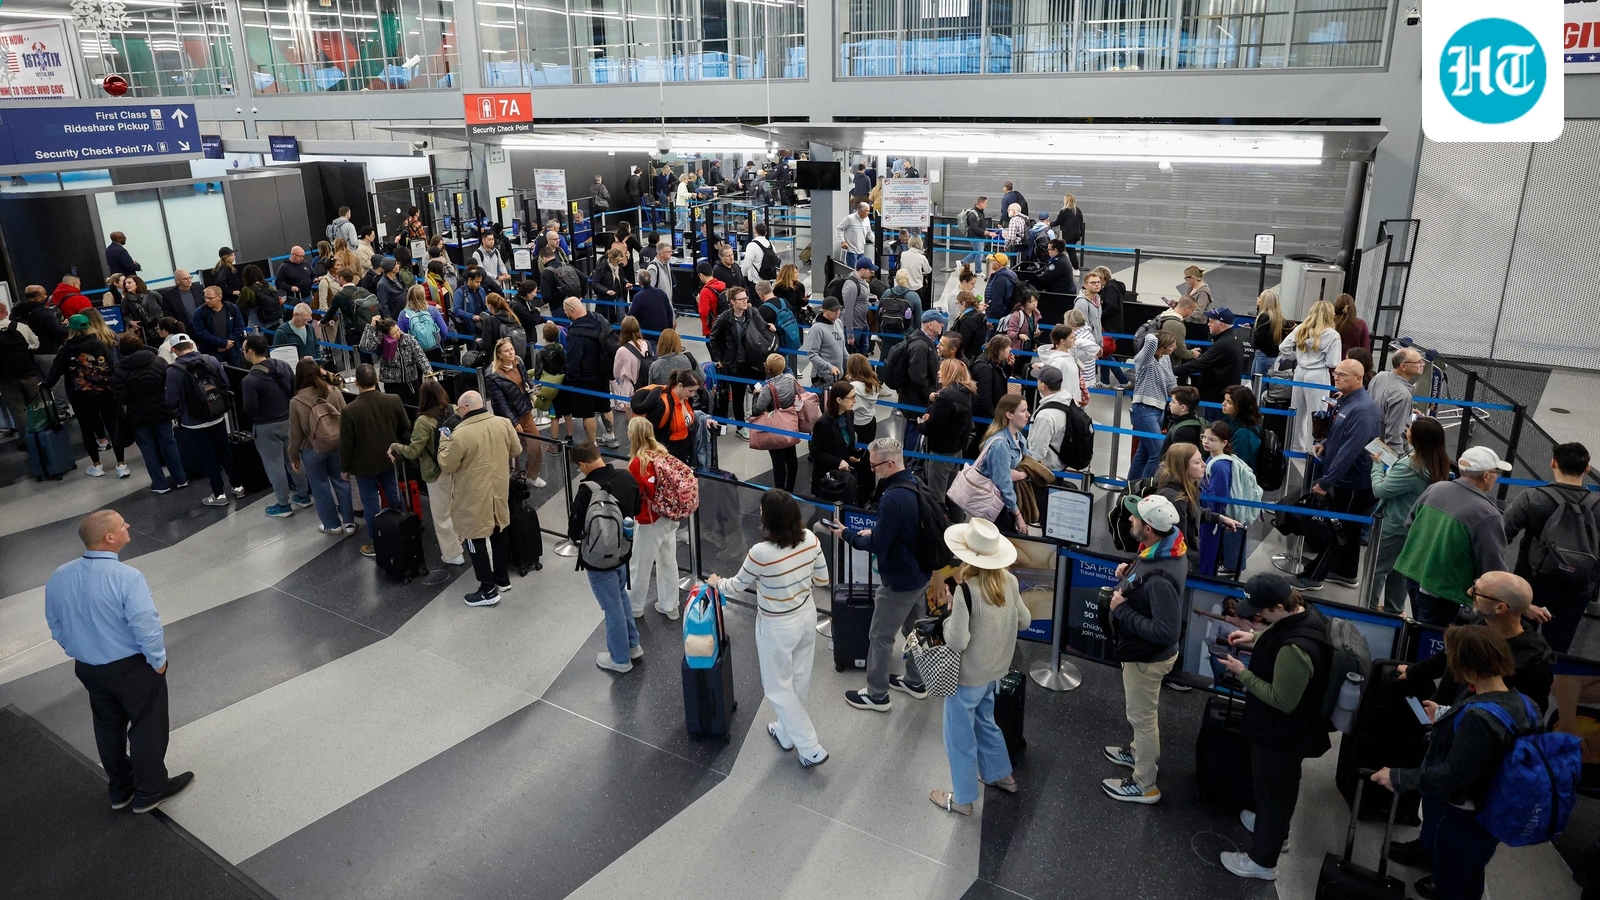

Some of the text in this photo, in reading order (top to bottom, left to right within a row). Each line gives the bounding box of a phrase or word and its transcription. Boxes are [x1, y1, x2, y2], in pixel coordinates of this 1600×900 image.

[9, 34, 24, 45] NOW
[12, 86, 20, 96] TO
[20, 85, 37, 95] THOSE
[37, 85, 50, 95] WHO
[51, 84, 65, 95] GAVE
[498, 99, 521, 117] 7A
[95, 110, 147, 120] First Class
[64, 122, 150, 133] Rideshare Pickup
[472, 126, 496, 134] Security
[35, 144, 154, 160] Security Check Point 7A
[501, 200, 507, 208] 5
[849, 515, 865, 526] TSA
[1080, 559, 1115, 575] TSA Pre
[1080, 569, 1095, 577] Travel
[1095, 572, 1108, 580] With
[1083, 611, 1095, 619] so
[1429, 638, 1445, 650] TS
